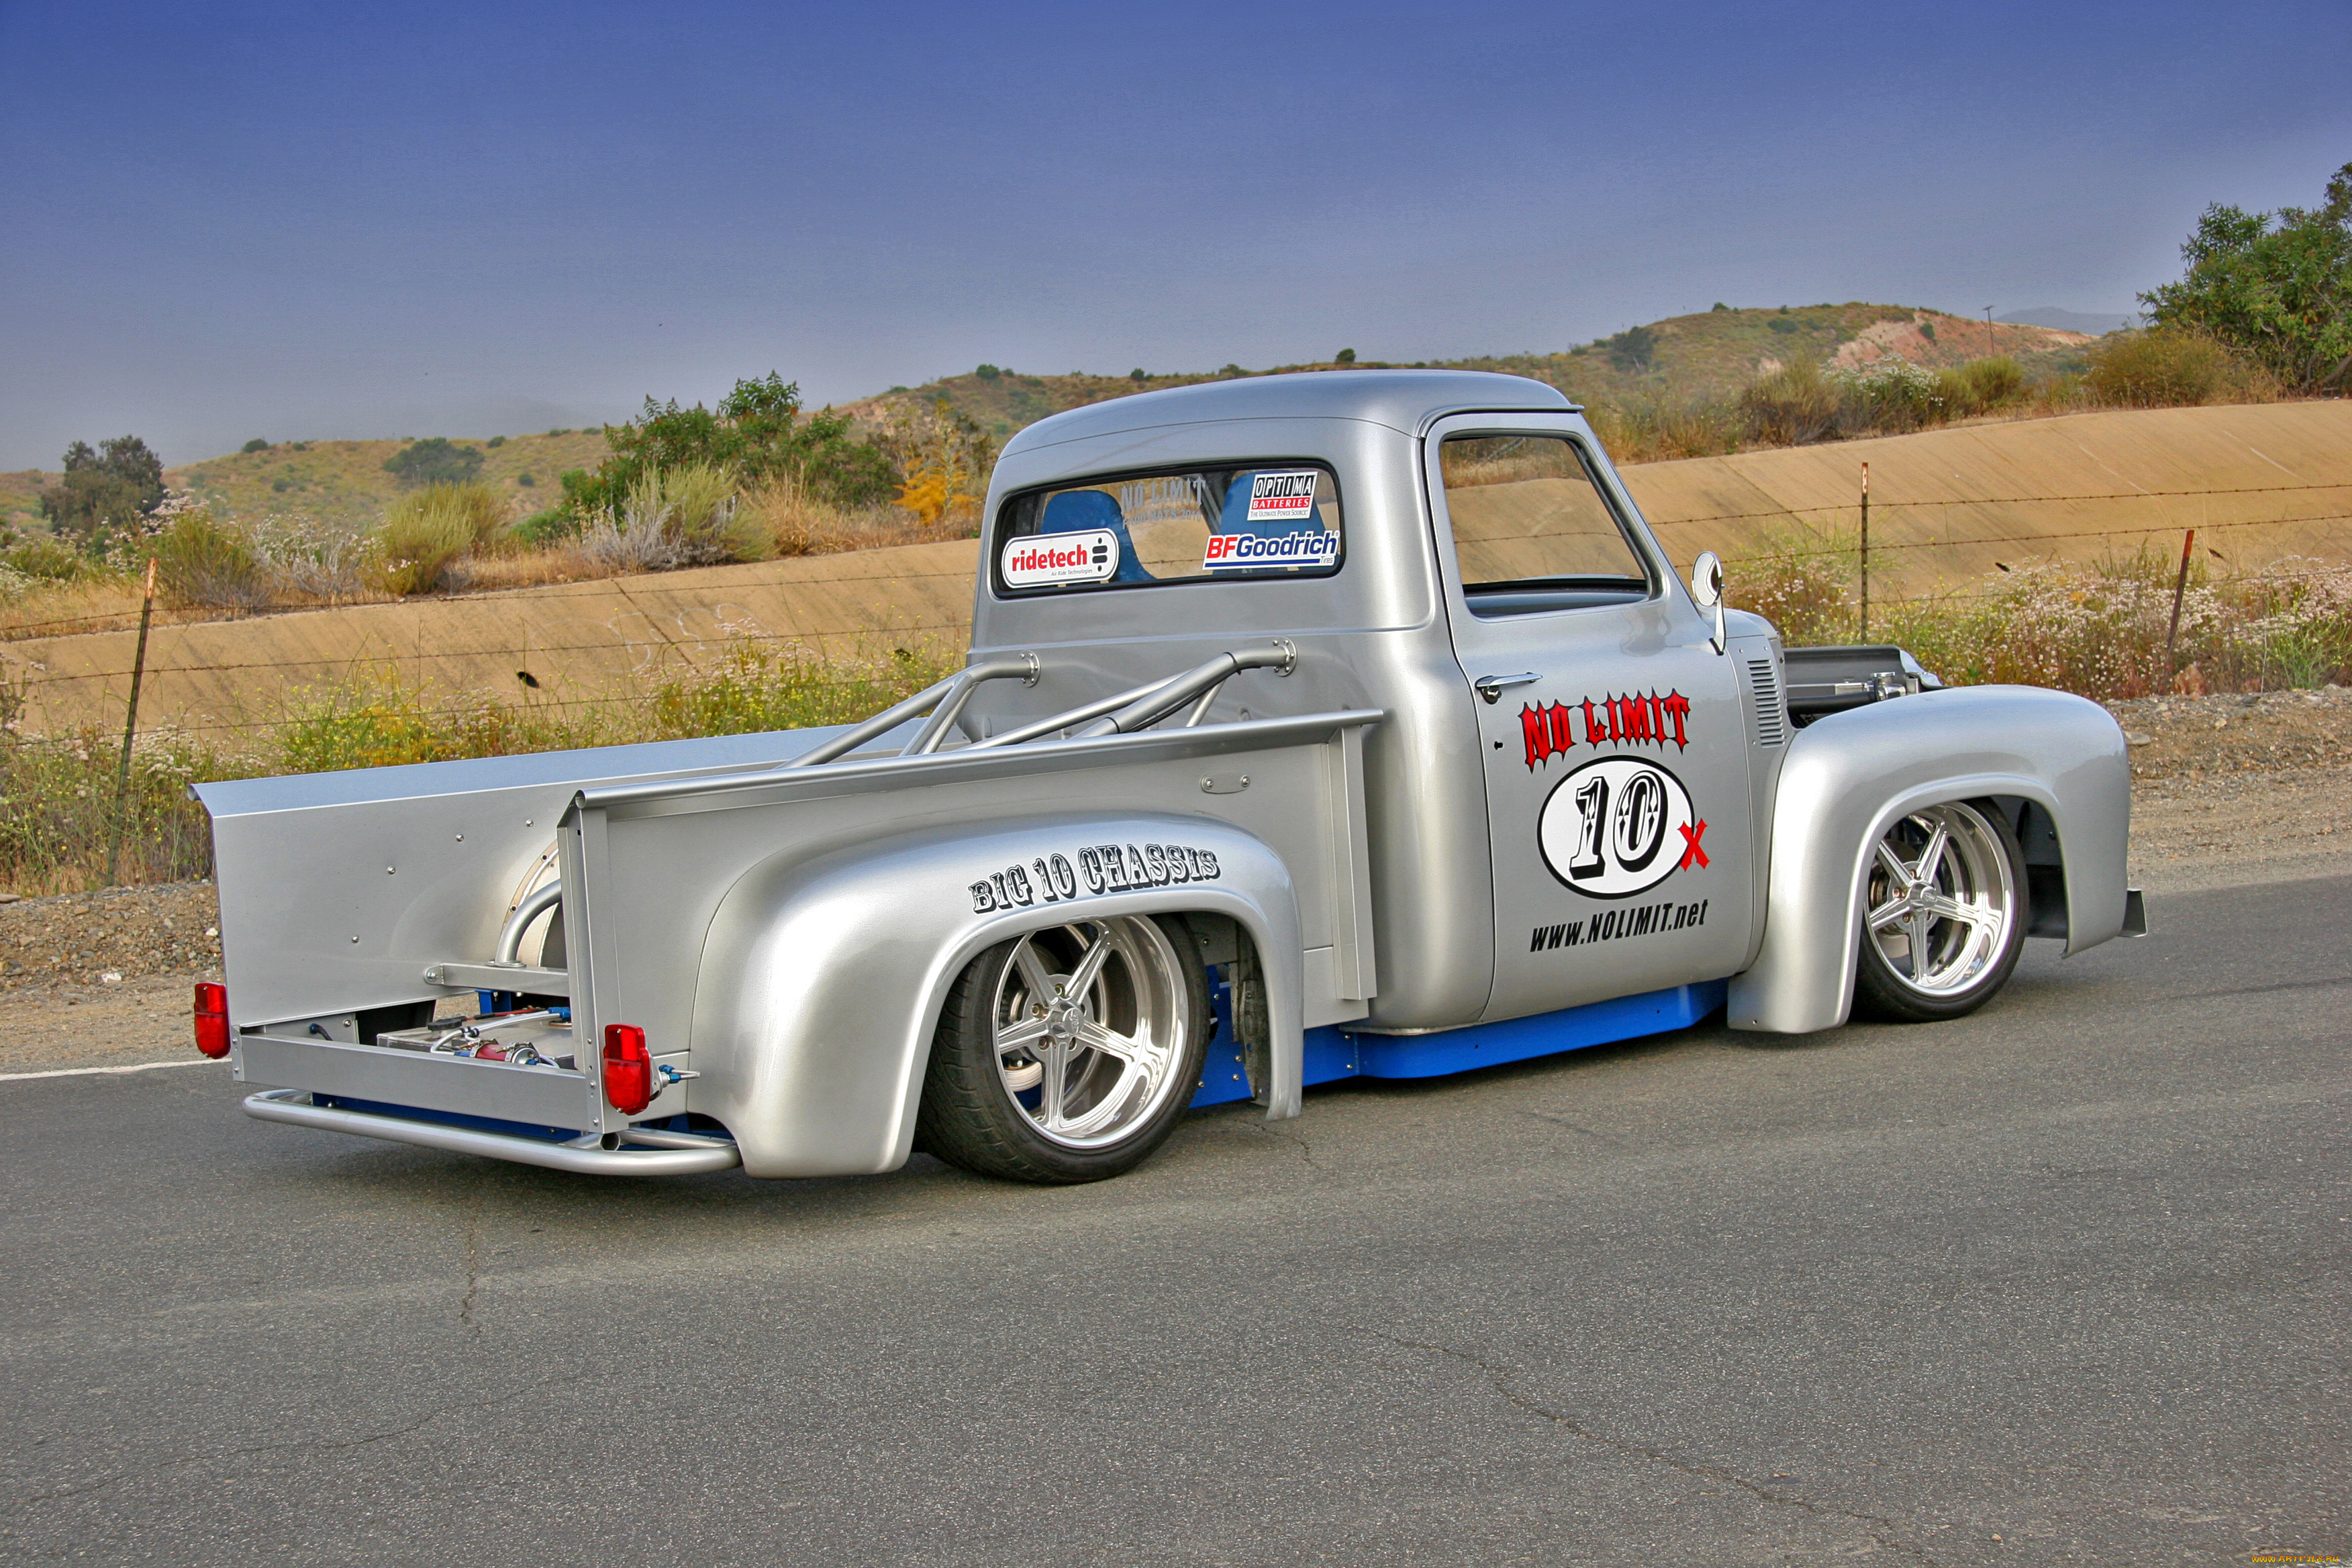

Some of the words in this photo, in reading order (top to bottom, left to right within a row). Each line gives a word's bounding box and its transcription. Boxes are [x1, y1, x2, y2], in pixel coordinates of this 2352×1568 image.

[1120, 484, 1144, 517] NO
[1151, 476, 1206, 508] LIMIT
[1252, 498, 1310, 509] BATTERIES
[1254, 476, 1314, 497] OPTIMA
[1012, 544, 1087, 571] ridetech
[1207, 530, 1337, 558] BFGoodrich
[1320, 556, 1333, 564] Tires
[1518, 699, 1577, 774] NO
[1575, 686, 1690, 755] LIMIT
[1569, 770, 1668, 880] 10
[968, 865, 1034, 914] BIG
[1033, 852, 1077, 901] 10
[1077, 843, 1222, 895] CHASSIS
[1530, 899, 1708, 952] www.NOLIMIT.net
